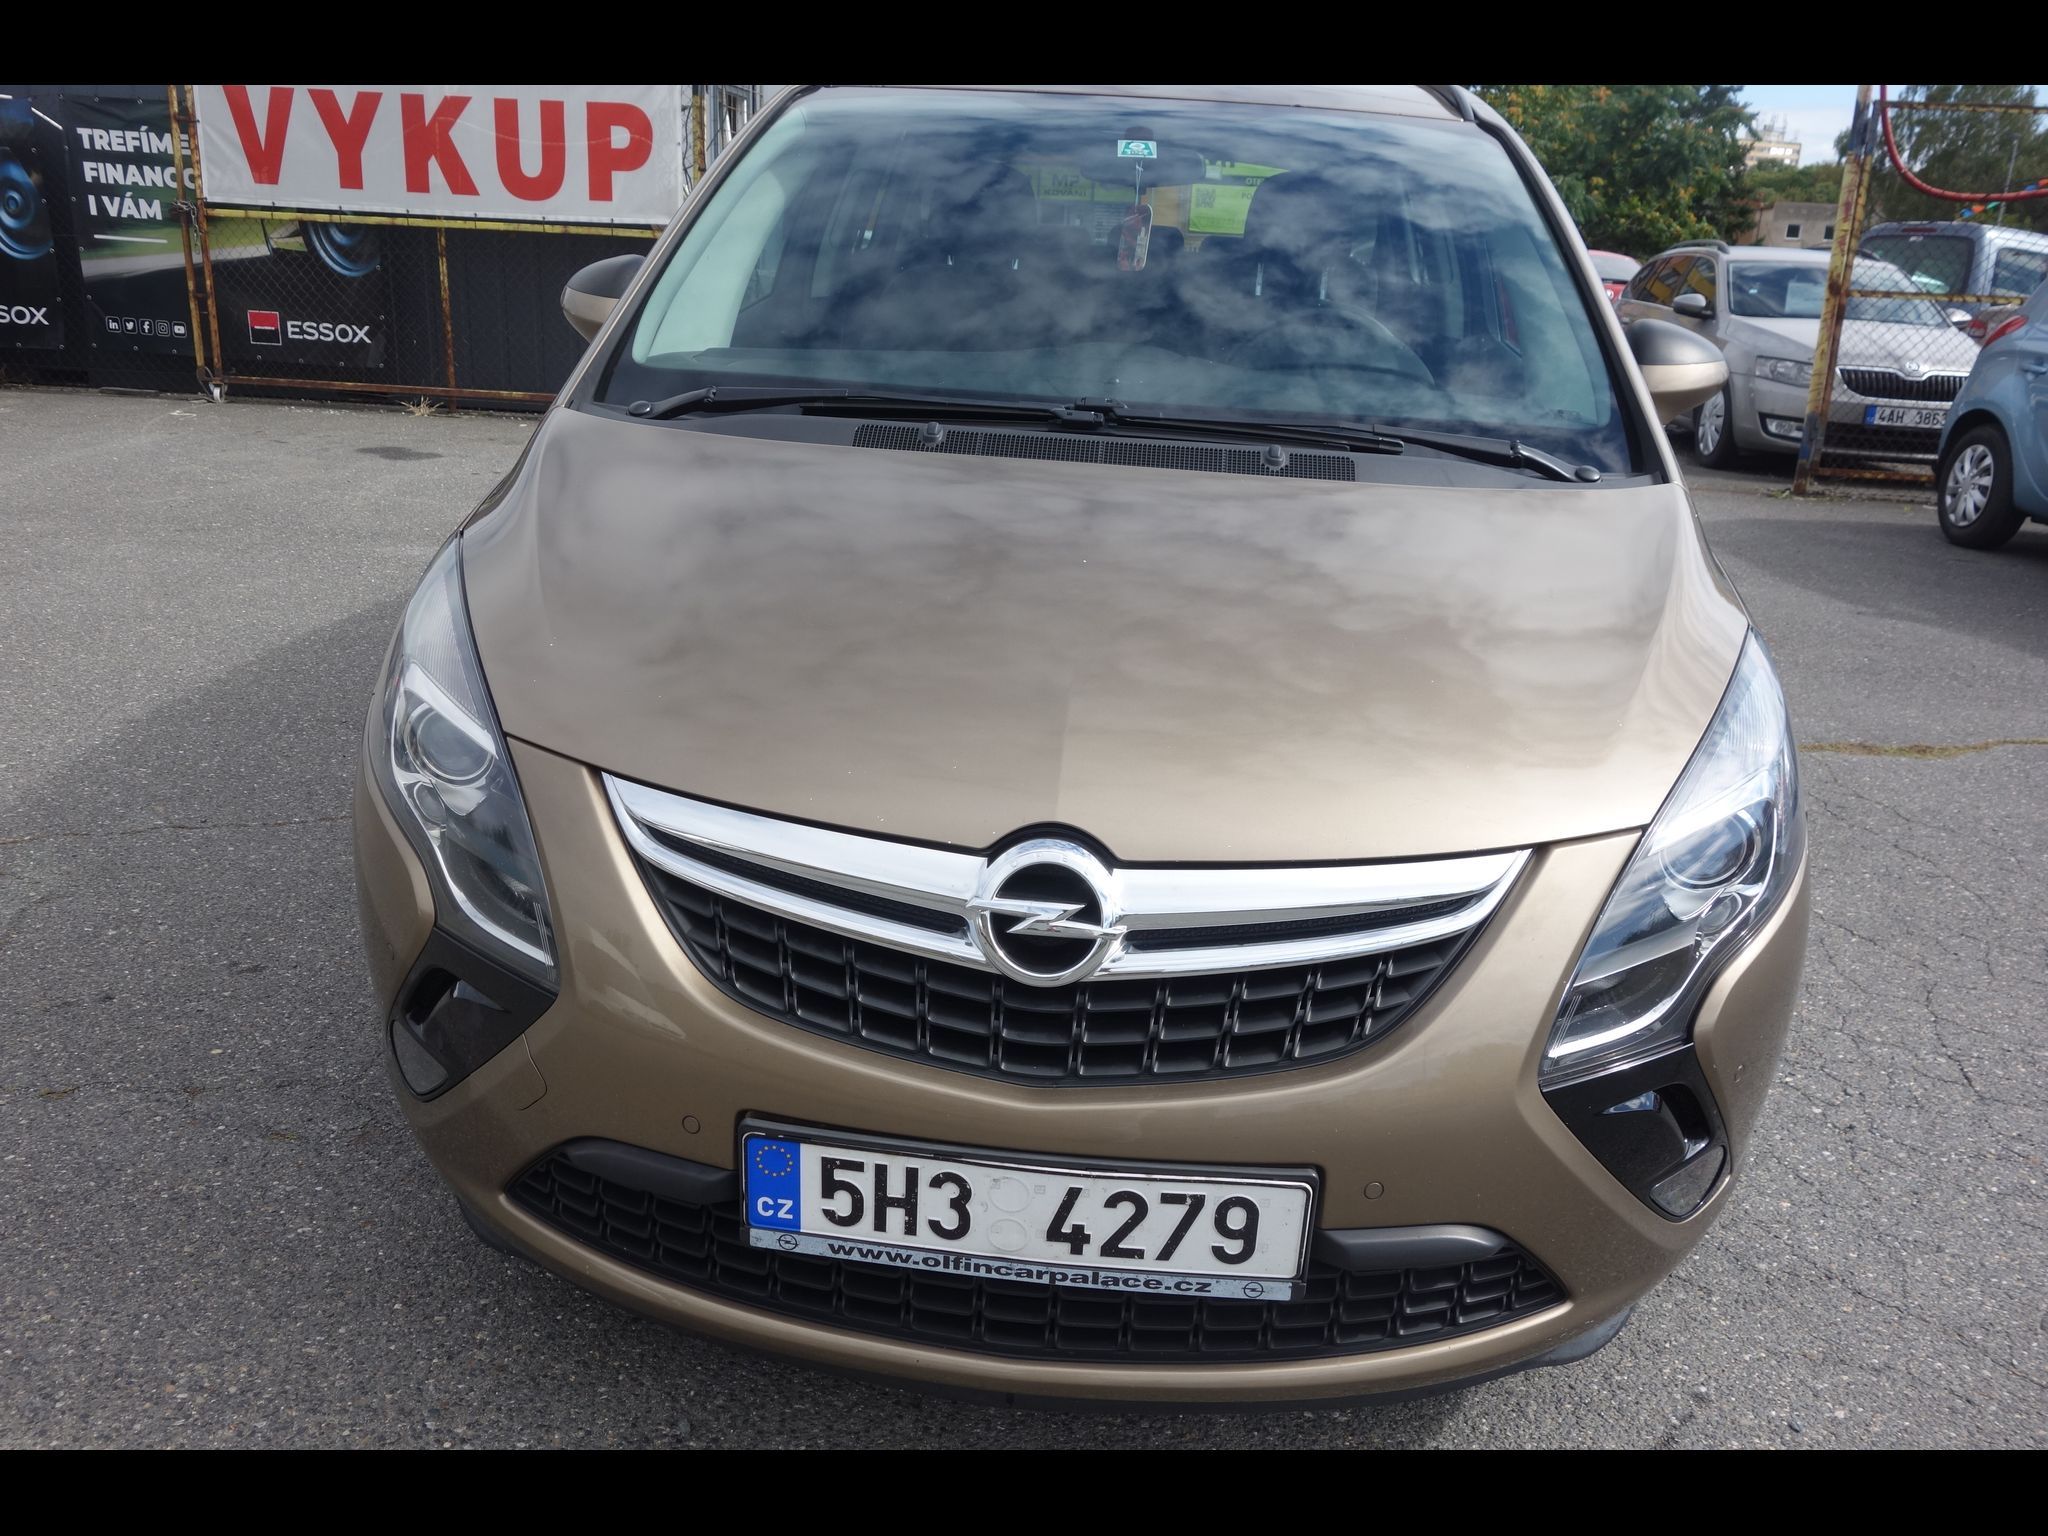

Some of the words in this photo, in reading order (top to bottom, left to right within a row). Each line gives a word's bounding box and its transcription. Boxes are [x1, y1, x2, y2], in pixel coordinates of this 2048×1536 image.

[221, 85, 654, 202] VYKUP
[88, 194, 98, 216] I
[101, 192, 163, 220] VÁM
[286, 320, 372, 344] ESSOX
[757, 1196, 794, 1220] CZ
[821, 1156, 972, 1241] 5H3
[1046, 1186, 1260, 1265] 4279
[827, 1242, 1212, 1293] www.olfincarpalace.cz
